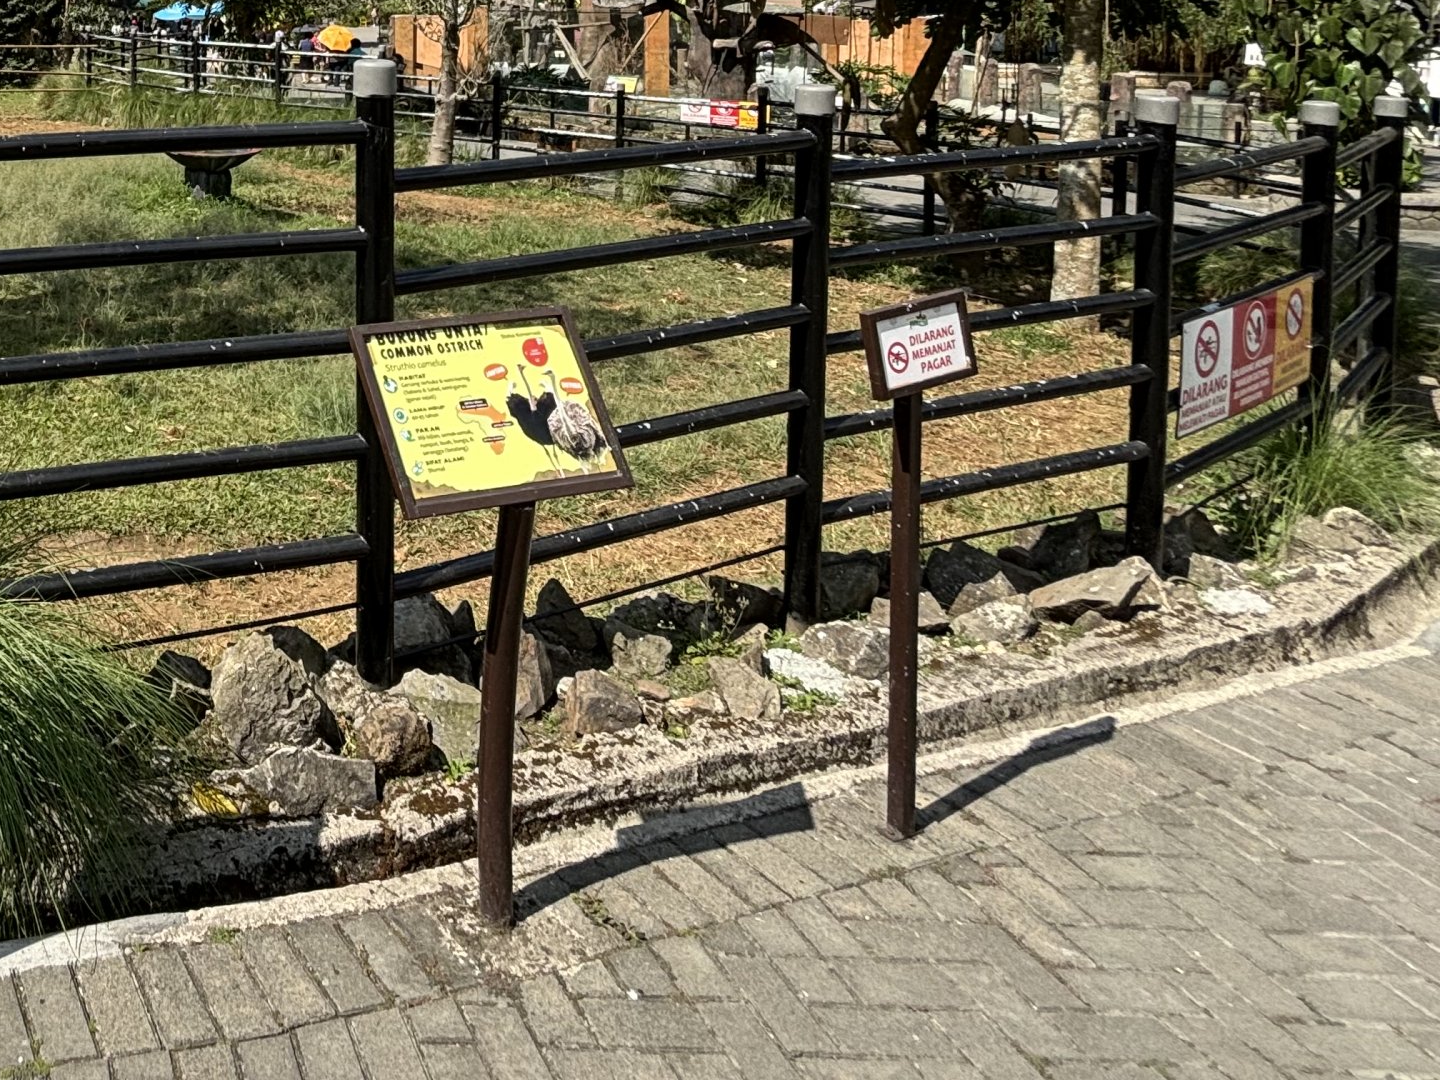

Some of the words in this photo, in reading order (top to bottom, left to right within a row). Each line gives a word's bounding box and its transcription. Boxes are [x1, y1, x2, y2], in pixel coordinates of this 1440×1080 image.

[377, 329, 437, 346] BURUNG
[909, 325, 955, 347] DILARANG
[380, 344, 433, 360] COMMON
[437, 339, 484, 354] OSTRICH
[912, 339, 956, 361] MEMANJAT
[921, 355, 953, 373] PAGAR
[1182, 374, 1228, 406] DILARANG
